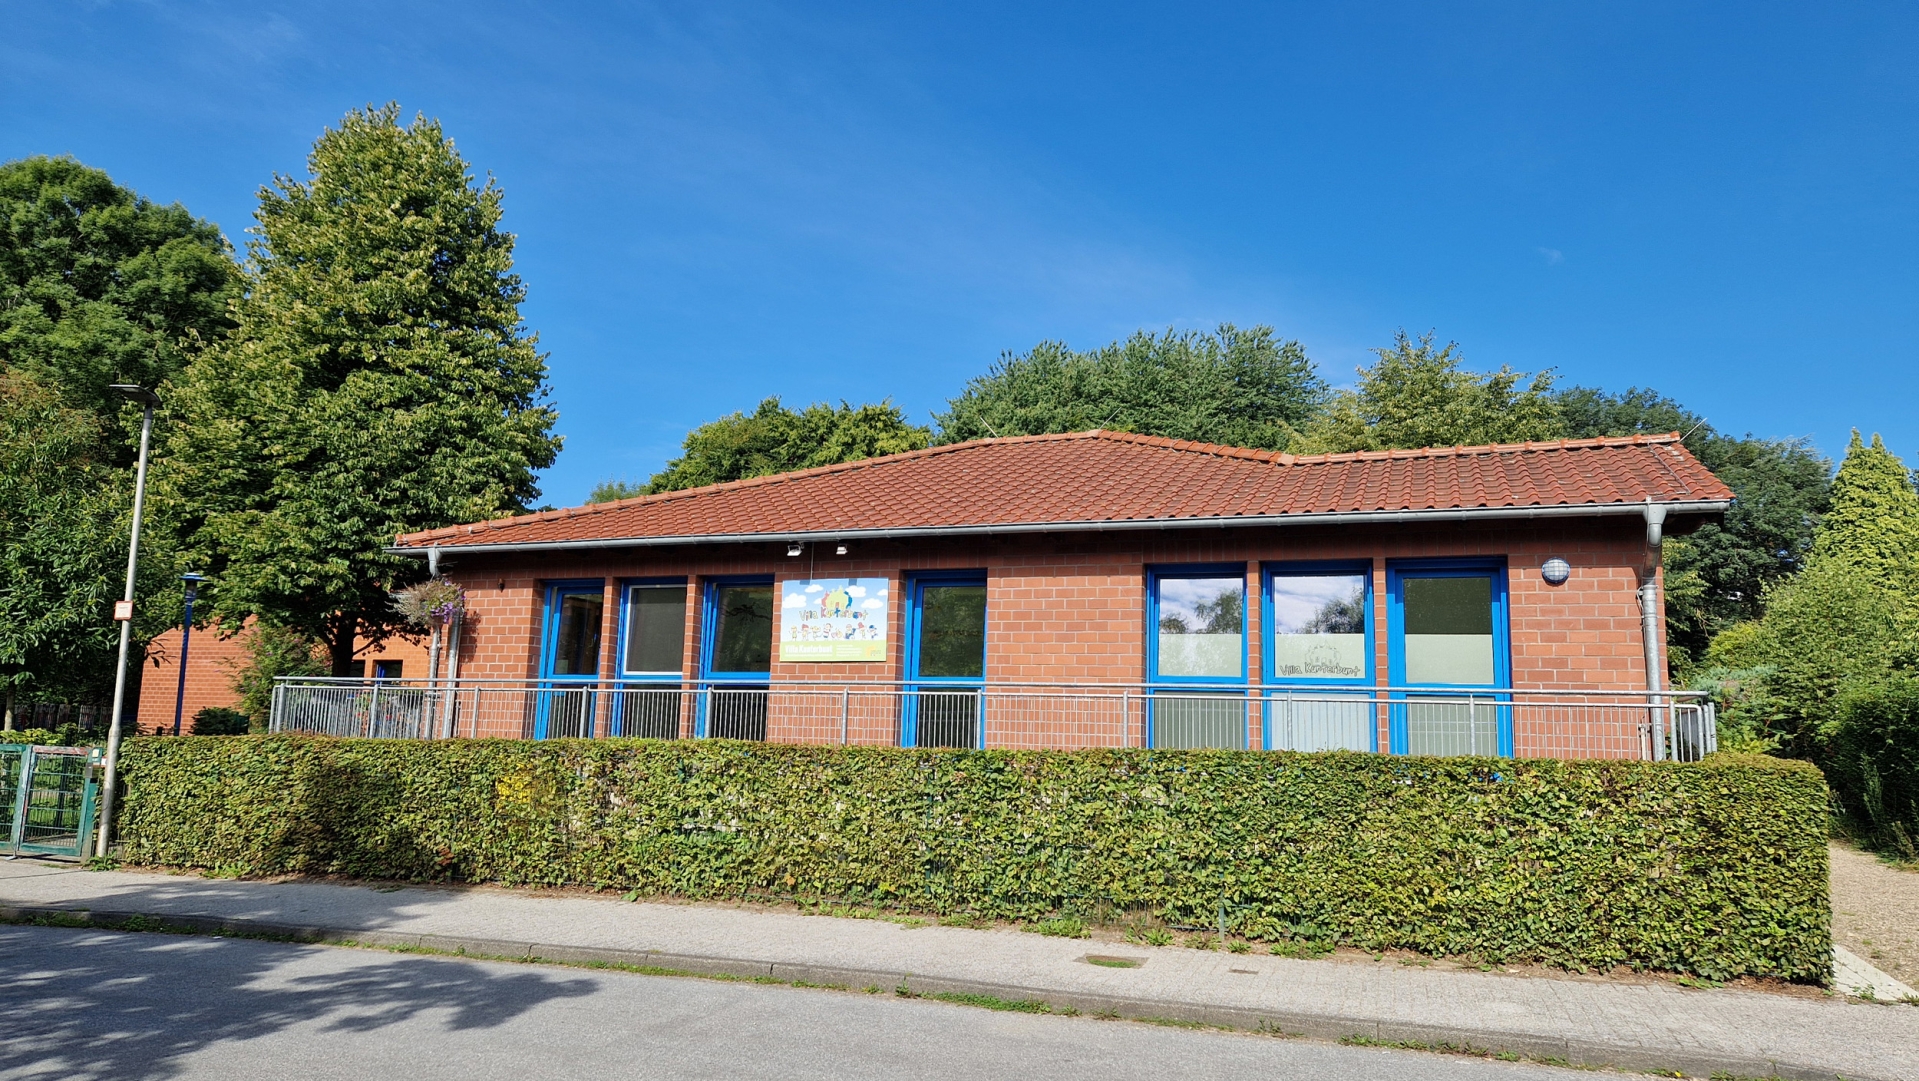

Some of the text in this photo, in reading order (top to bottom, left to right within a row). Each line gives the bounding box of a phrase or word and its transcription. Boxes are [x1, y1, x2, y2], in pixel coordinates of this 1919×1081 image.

[799, 607, 869, 621] Villa Kunterbunt
[785, 645, 798, 653] Villa
[798, 645, 833, 653] Kunterbunt
[1279, 662, 1361, 677] Villa Kunterbunt
